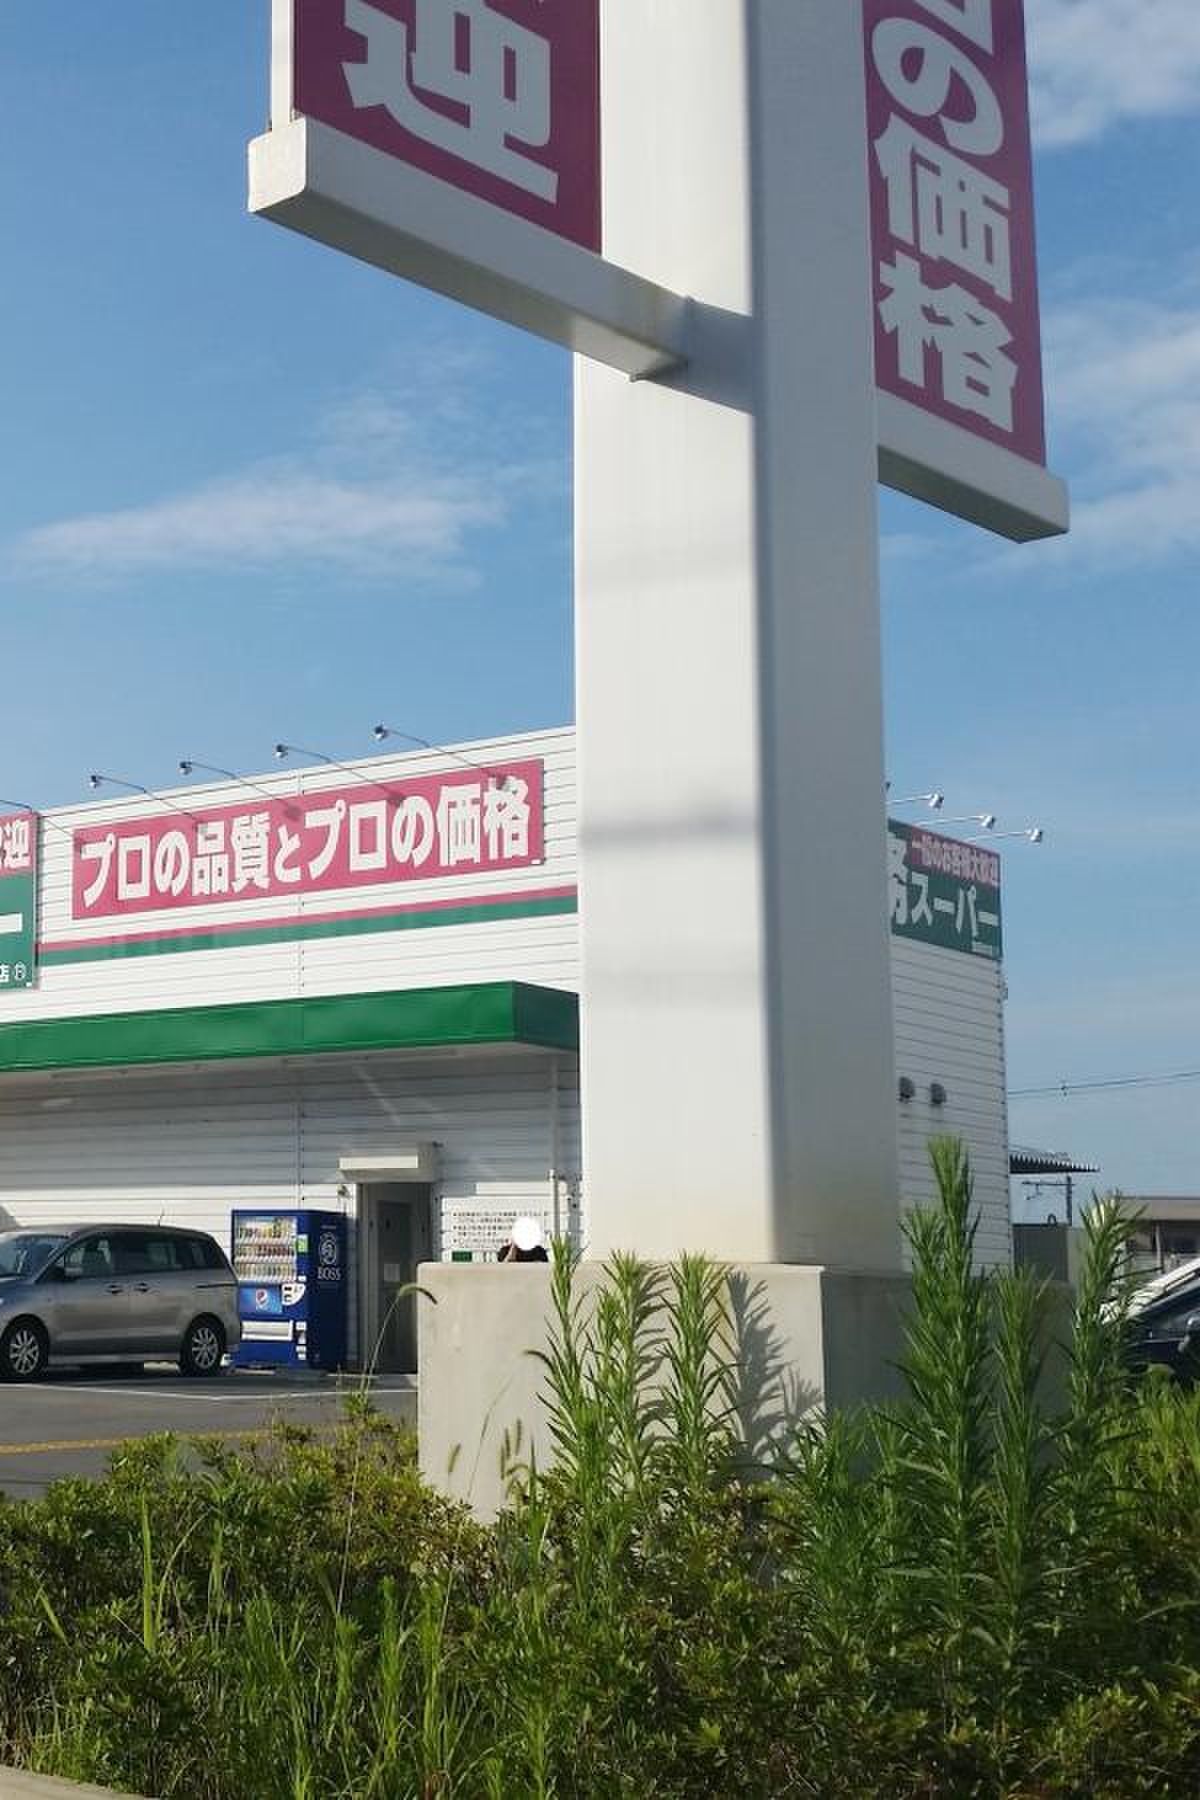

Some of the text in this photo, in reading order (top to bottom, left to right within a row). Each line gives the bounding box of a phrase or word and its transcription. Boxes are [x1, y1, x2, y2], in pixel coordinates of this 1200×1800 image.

[81, 776, 530, 907] プロの品質とプロの価格
